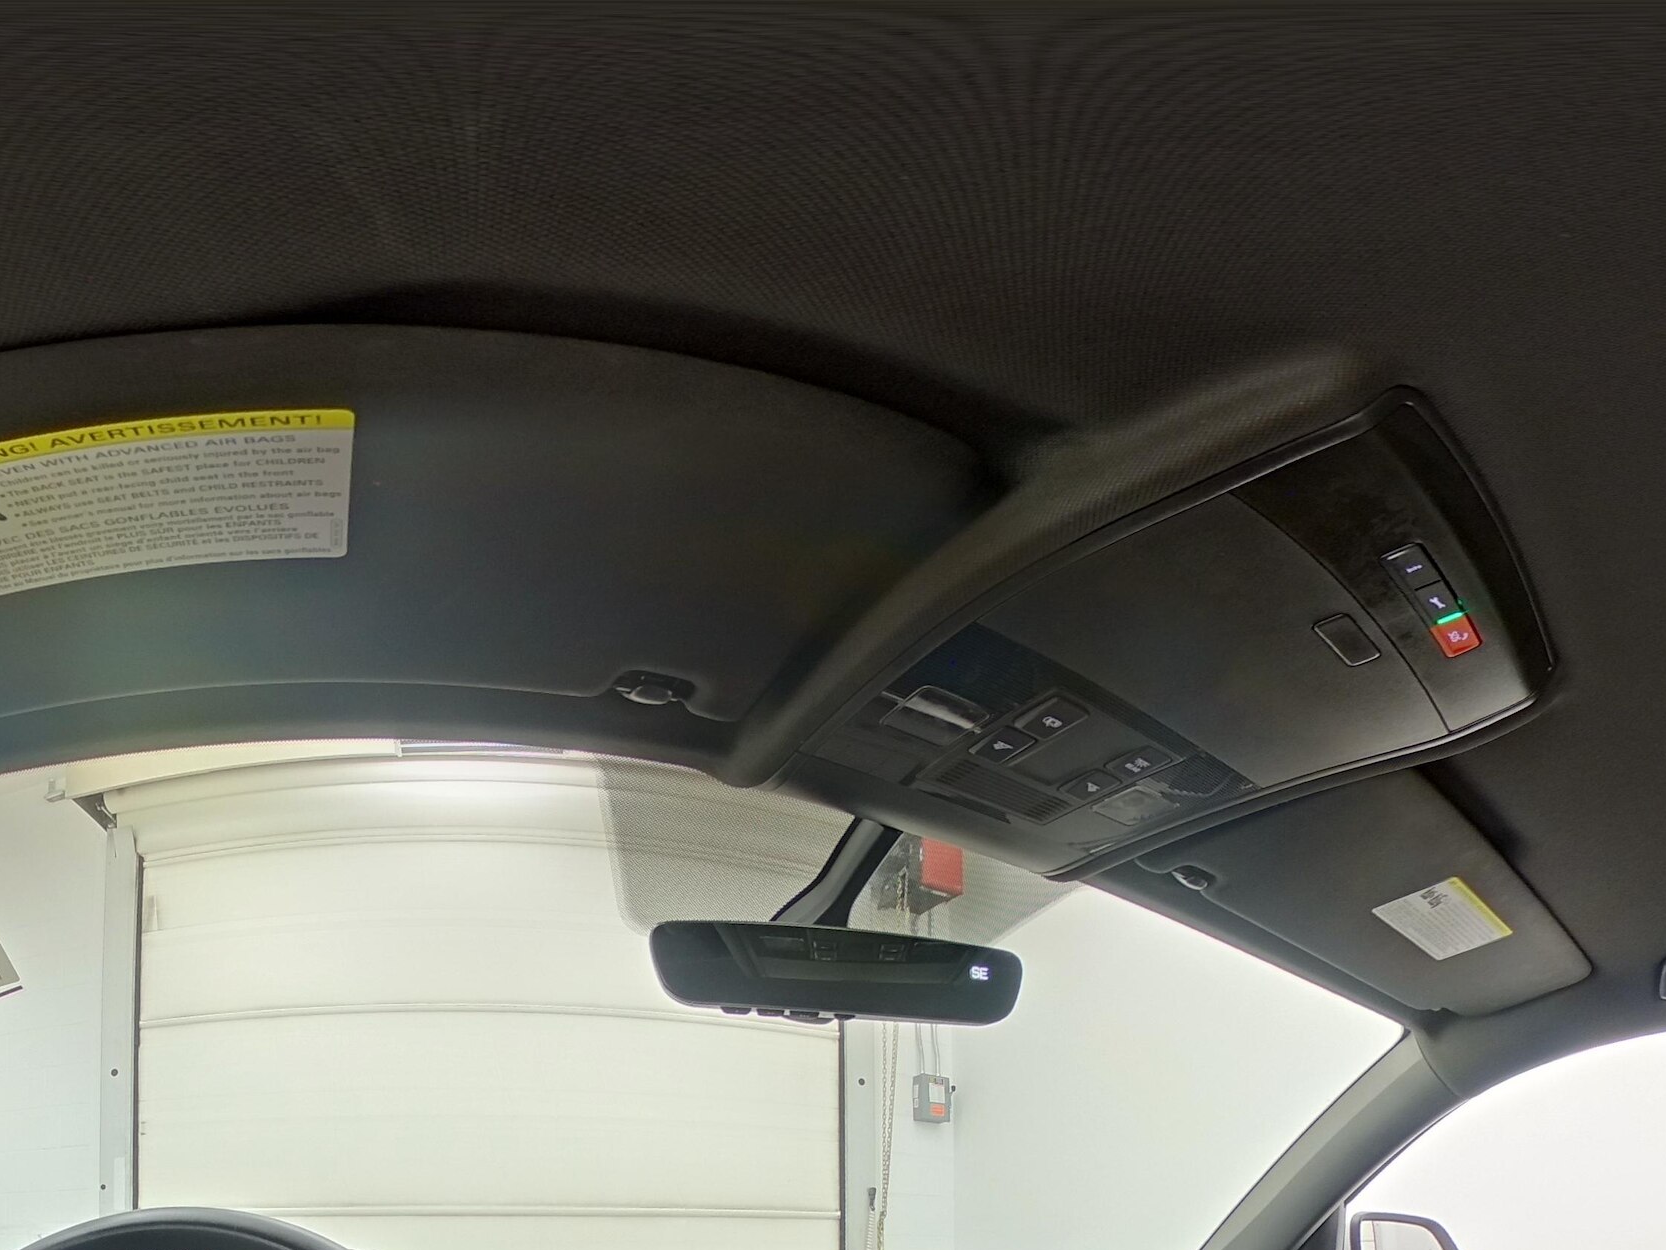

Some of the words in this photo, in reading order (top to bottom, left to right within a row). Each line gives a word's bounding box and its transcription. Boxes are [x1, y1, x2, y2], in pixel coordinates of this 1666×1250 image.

[49, 415, 322, 449] AVERTISSEMENT!
[40, 454, 88, 468] WITH
[95, 440, 198, 460] ADVANCED
[205, 437, 237, 447] AIR
[244, 434, 295, 445] BAGS
[51, 470, 71, 478] can
[252, 448, 266, 456] by
[316, 446, 340, 454] bag
[118, 471, 137, 479] the
[195, 462, 228, 471] place
[255, 457, 325, 466] CHILDREN
[159, 476, 189, 484] child
[263, 469, 294, 477] front
[173, 486, 196, 494] and
[198, 483, 238, 493] CHILD
[241, 479, 324, 488] RESTRAINTS
[314, 491, 342, 499] bags
[25, 528, 55, 540] DES
[59, 521, 101, 533] SACS
[104, 507, 209, 526] GONFLABLES
[970, 965, 989, 981] SE
